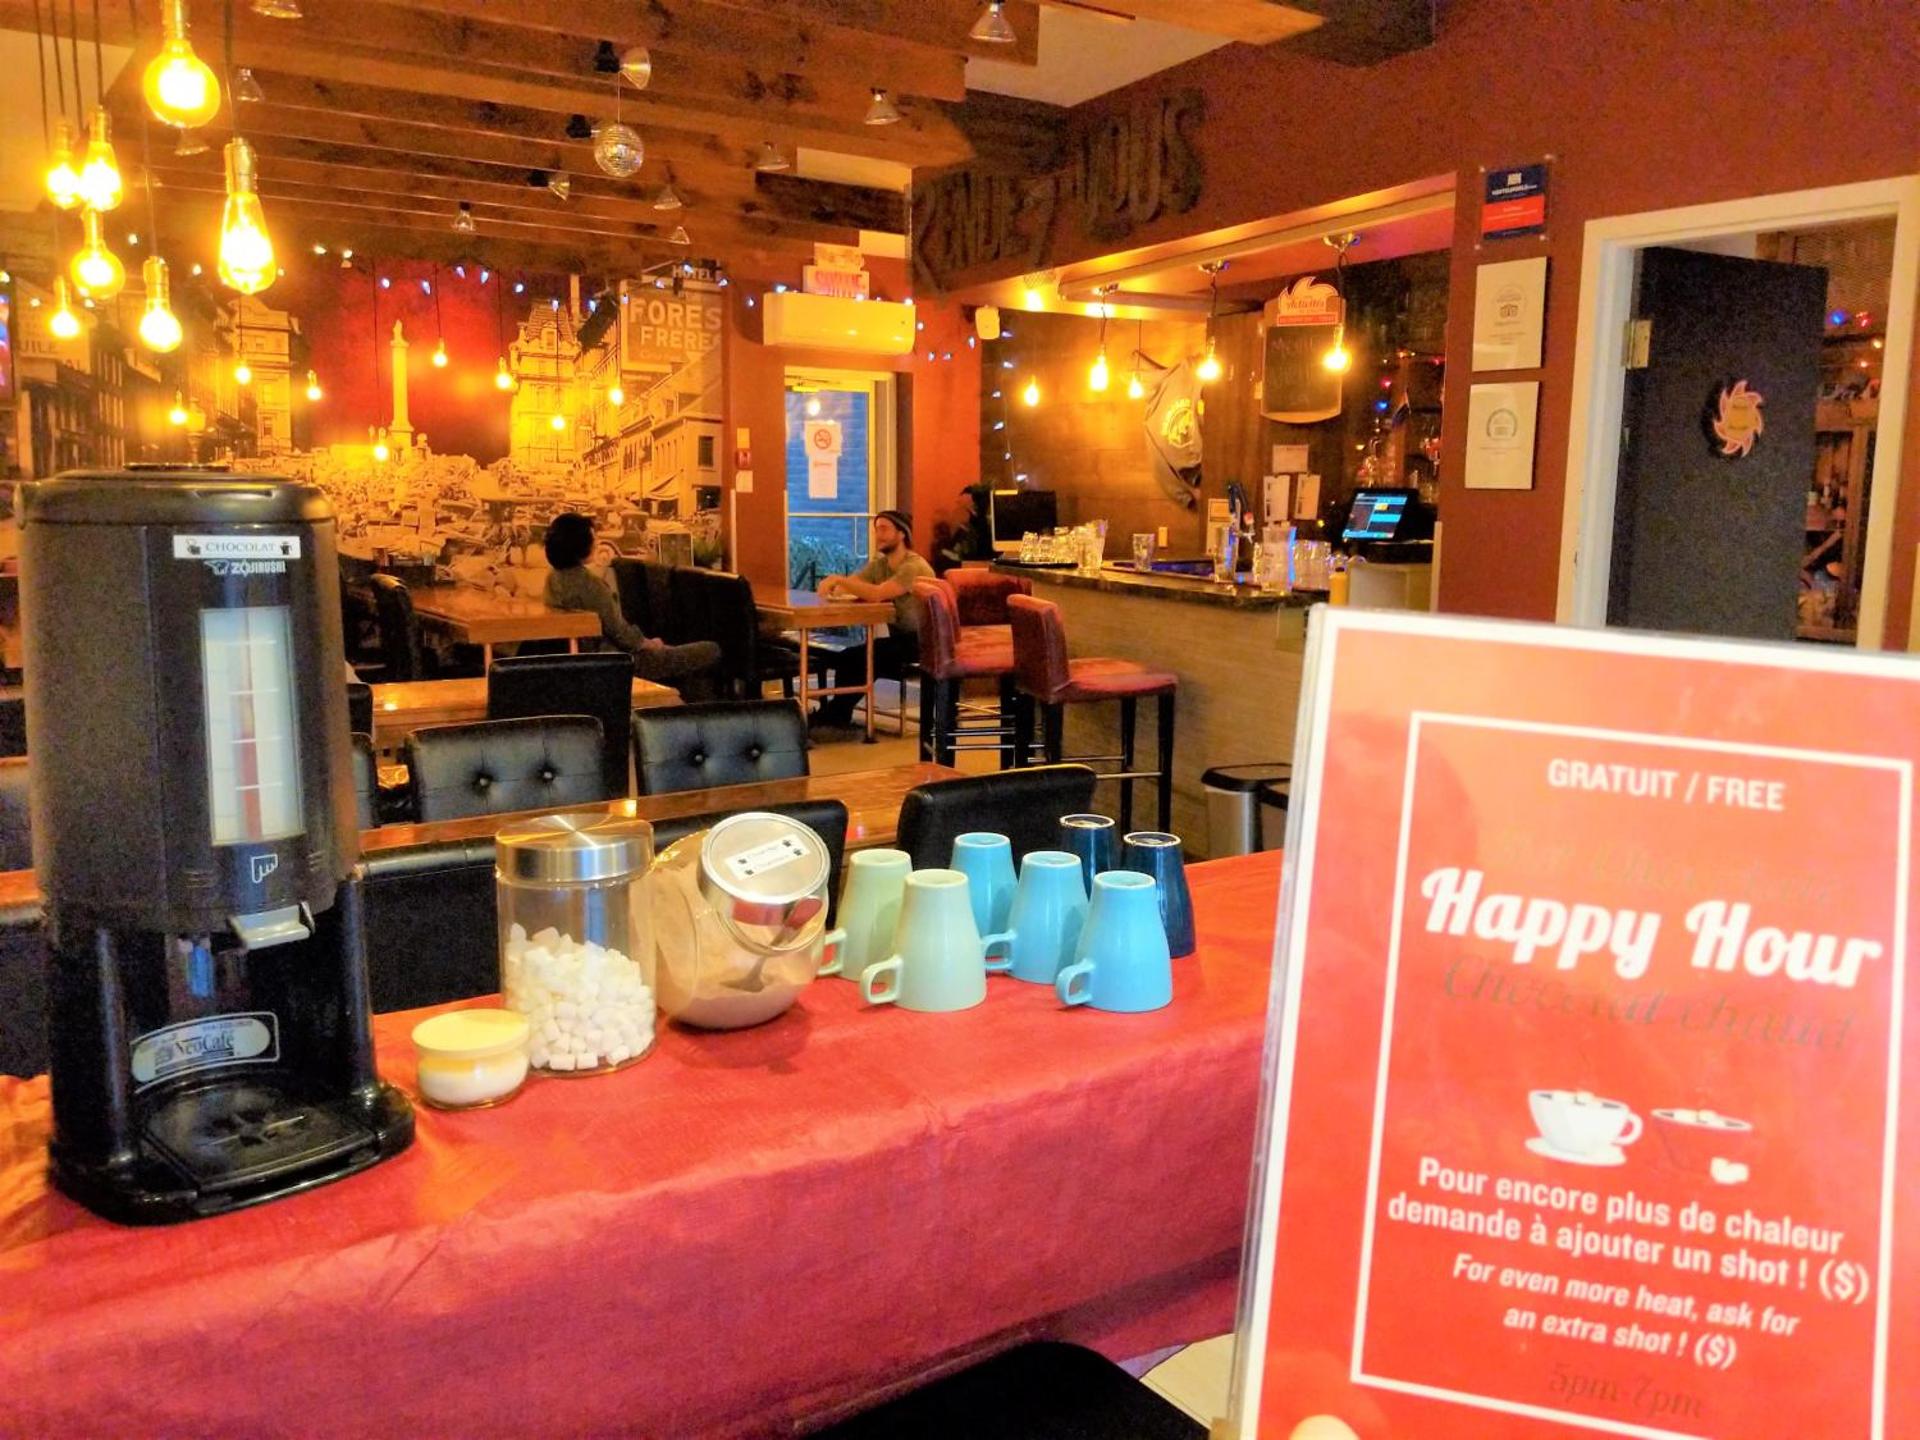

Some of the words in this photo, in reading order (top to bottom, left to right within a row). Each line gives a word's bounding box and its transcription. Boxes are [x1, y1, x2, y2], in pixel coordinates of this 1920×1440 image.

[205, 542, 276, 553] CHOCOLAT
[1547, 758, 1679, 799] GRATUIT
[1685, 772, 1699, 803] /
[1706, 775, 1786, 812] FREE
[1420, 866, 1661, 980] Happy
[1684, 899, 1883, 988] Hour
[1387, 1191, 1522, 1241] demande
[1528, 1214, 1548, 1246] à
[1555, 1227, 1665, 1265] ajouter
[1671, 1246, 1712, 1274] un
[1719, 1249, 1790, 1286] shot
[1798, 1259, 1807, 1289] !
[1818, 1260, 1870, 1304] ($)
[1418, 1156, 1489, 1195] Pour
[1495, 1177, 1599, 1214] encore
[1606, 1191, 1671, 1226] plus
[1678, 1200, 1717, 1234] de
[1724, 1209, 1844, 1254] chaleur
[1452, 1252, 1496, 1283] For
[1498, 1267, 1560, 1295] even
[1564, 1279, 1631, 1307] more
[1634, 1284, 1698, 1322] heat,
[1705, 1302, 1754, 1329] ask
[1760, 1306, 1801, 1337] for
[1502, 1307, 1537, 1331] an
[1541, 1314, 1608, 1344] extra
[1612, 1323, 1672, 1355] shot
[1676, 1332, 1688, 1357] !
[1692, 1334, 1738, 1371] ($)
